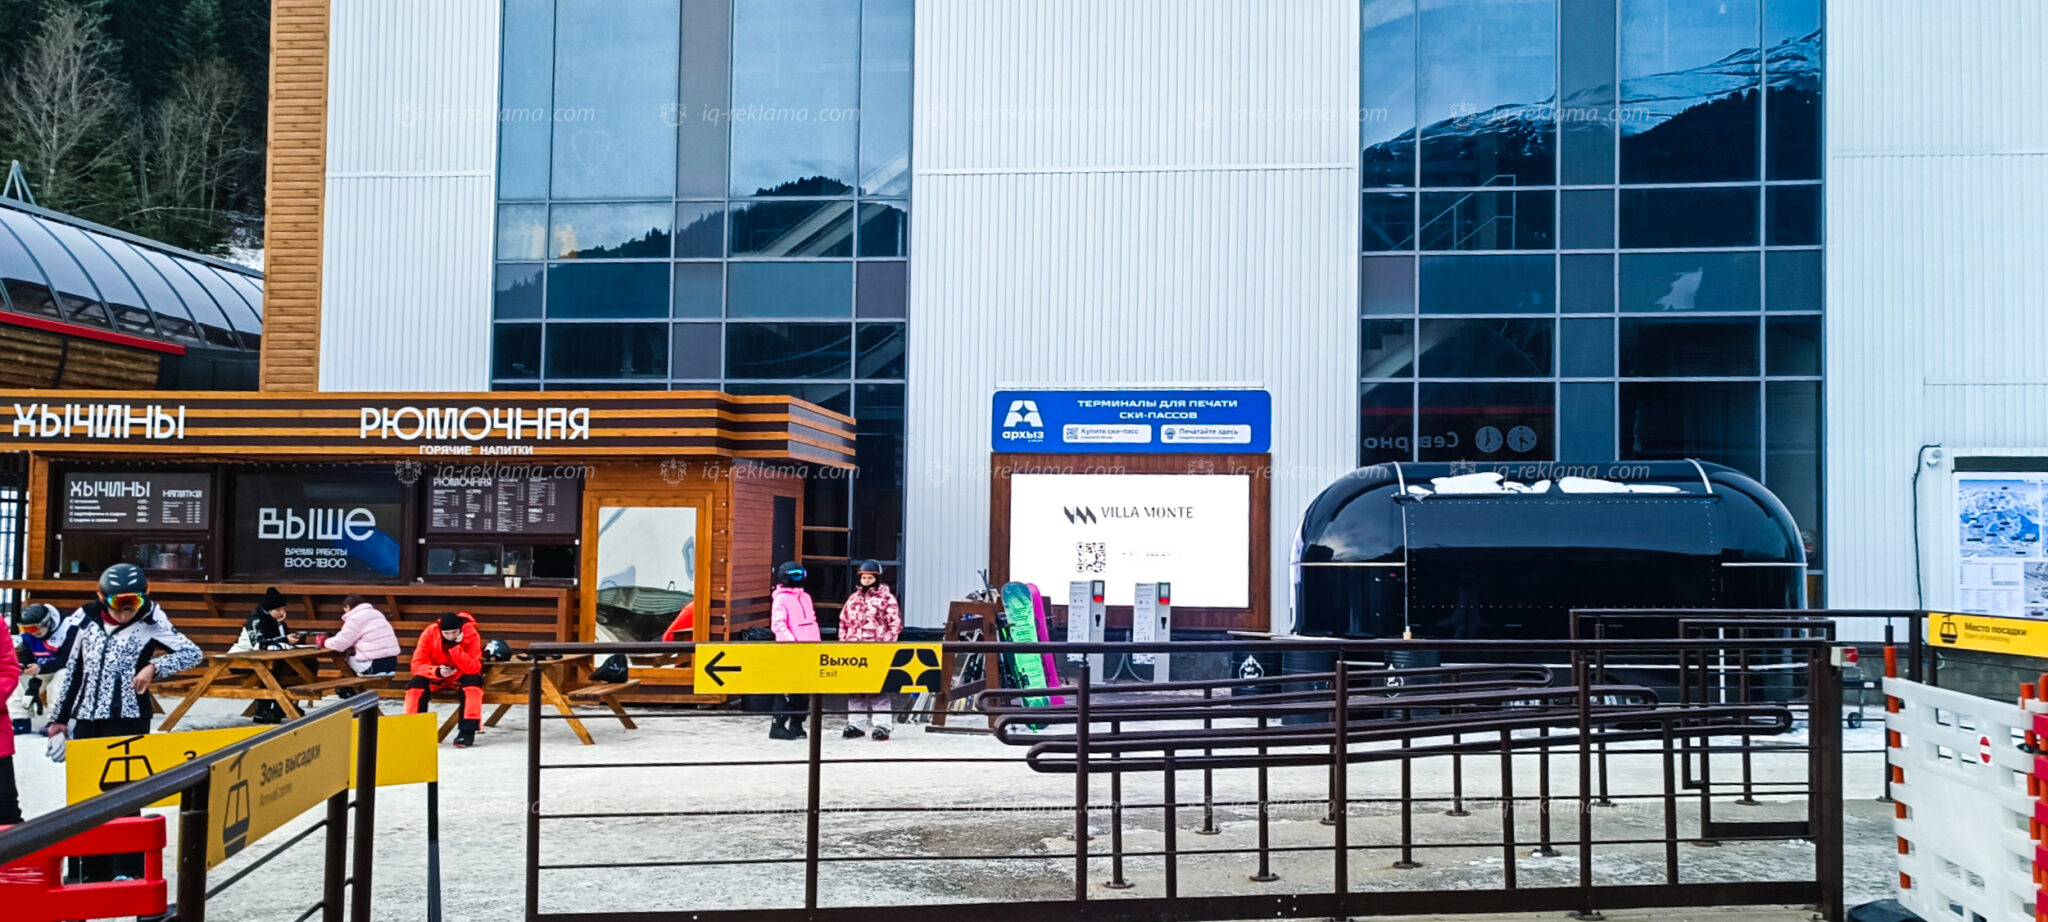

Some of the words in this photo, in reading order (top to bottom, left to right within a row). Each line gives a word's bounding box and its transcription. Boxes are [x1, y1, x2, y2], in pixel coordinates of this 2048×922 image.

[1078, 400, 1157, 408] ТЕРМИНАЛЫ
[1159, 400, 1187, 409] ДЛЯ
[1189, 400, 1238, 408] ПЕЧАТИ
[1119, 411, 1198, 419] СКИ-ПАССОВ
[13, 403, 185, 439] ХЫЧИНЫ
[360, 406, 590, 441] РЮМОЧНАЯ
[1002, 430, 1044, 441] архыз
[419, 445, 472, 456] ГОРЯЧИЕ
[480, 445, 534, 456] НАПИТКИ
[433, 477, 492, 487] РЮМОЧНАЯ
[1101, 506, 1139, 518] VILLA
[1143, 506, 1193, 518] MONTE
[316, 548, 348, 556] РАБОТЫ
[1964, 622, 1990, 633] Место
[1991, 626, 2028, 636] посадки
[819, 654, 868, 668] Выход
[819, 669, 838, 678] Exit
[260, 762, 283, 786] Зона
[285, 744, 322, 775] высадки
